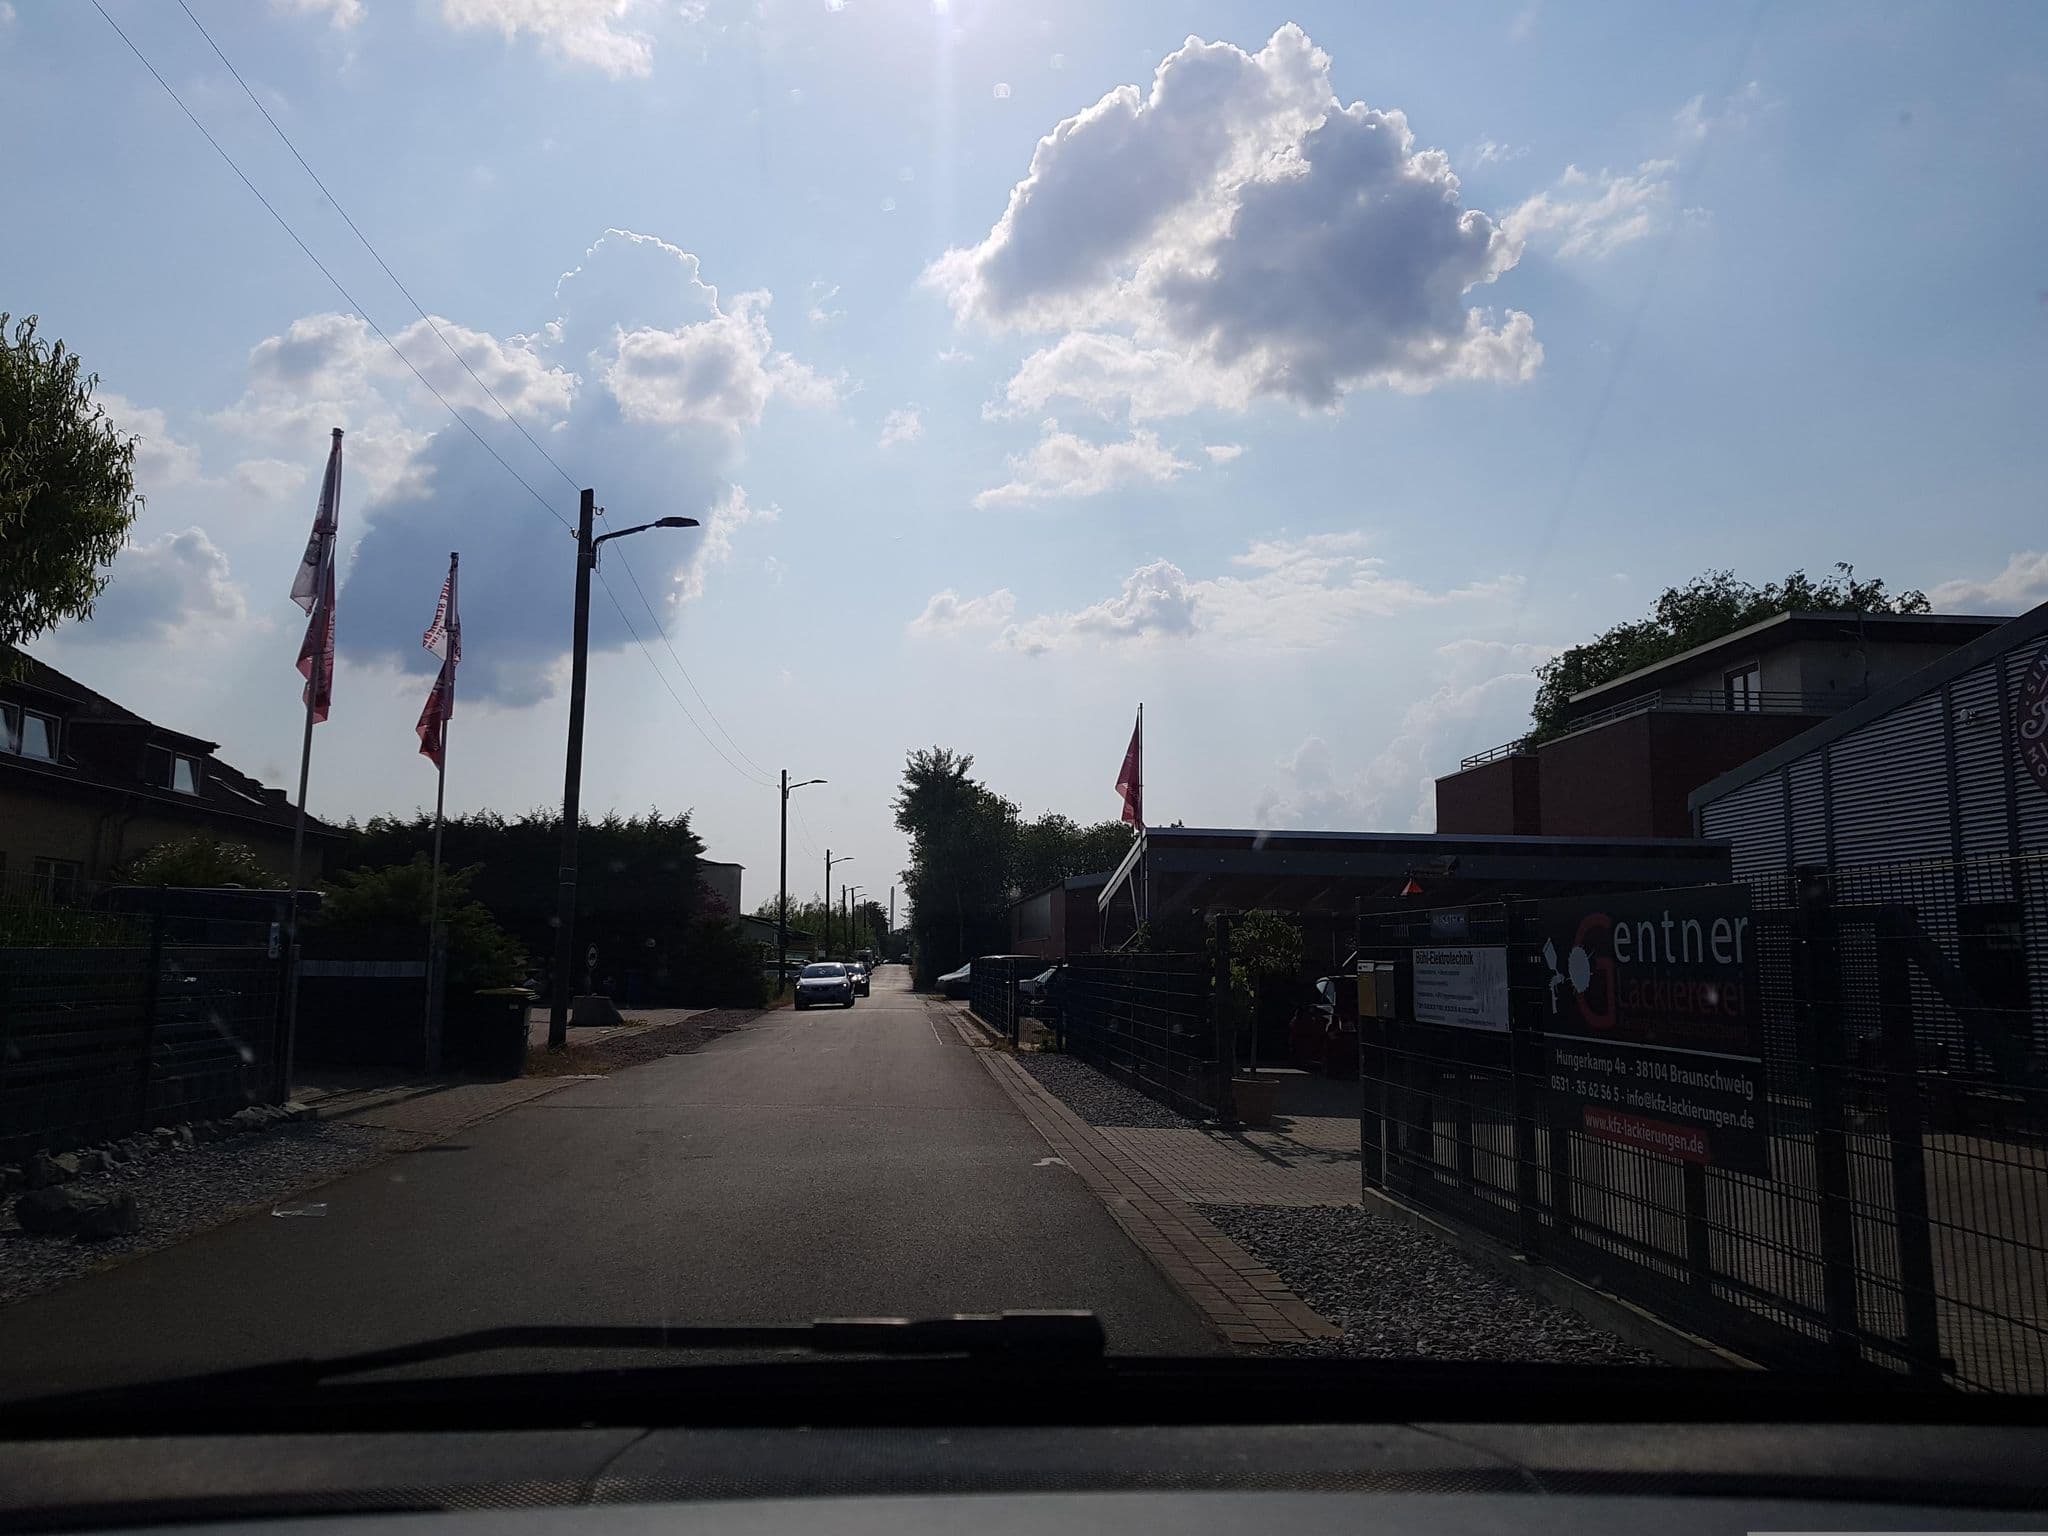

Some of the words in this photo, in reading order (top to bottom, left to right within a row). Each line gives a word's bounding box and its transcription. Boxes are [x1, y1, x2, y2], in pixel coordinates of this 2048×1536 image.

[1614, 1057, 1627, 1075] 4a
[1635, 1060, 1668, 1081] 38104
[1670, 1064, 1755, 1101] Braunschweig
[1551, 1074, 1569, 1091] 0531
[1576, 1080, 1587, 1095] 35
[1588, 1082, 1600, 1098] 62
[1601, 1084, 1612, 1101] 56
[1626, 1089, 1755, 1130] info@kfz-lackierungen.de
[1585, 1112, 1705, 1155] www.kfz-lackierungen.de
